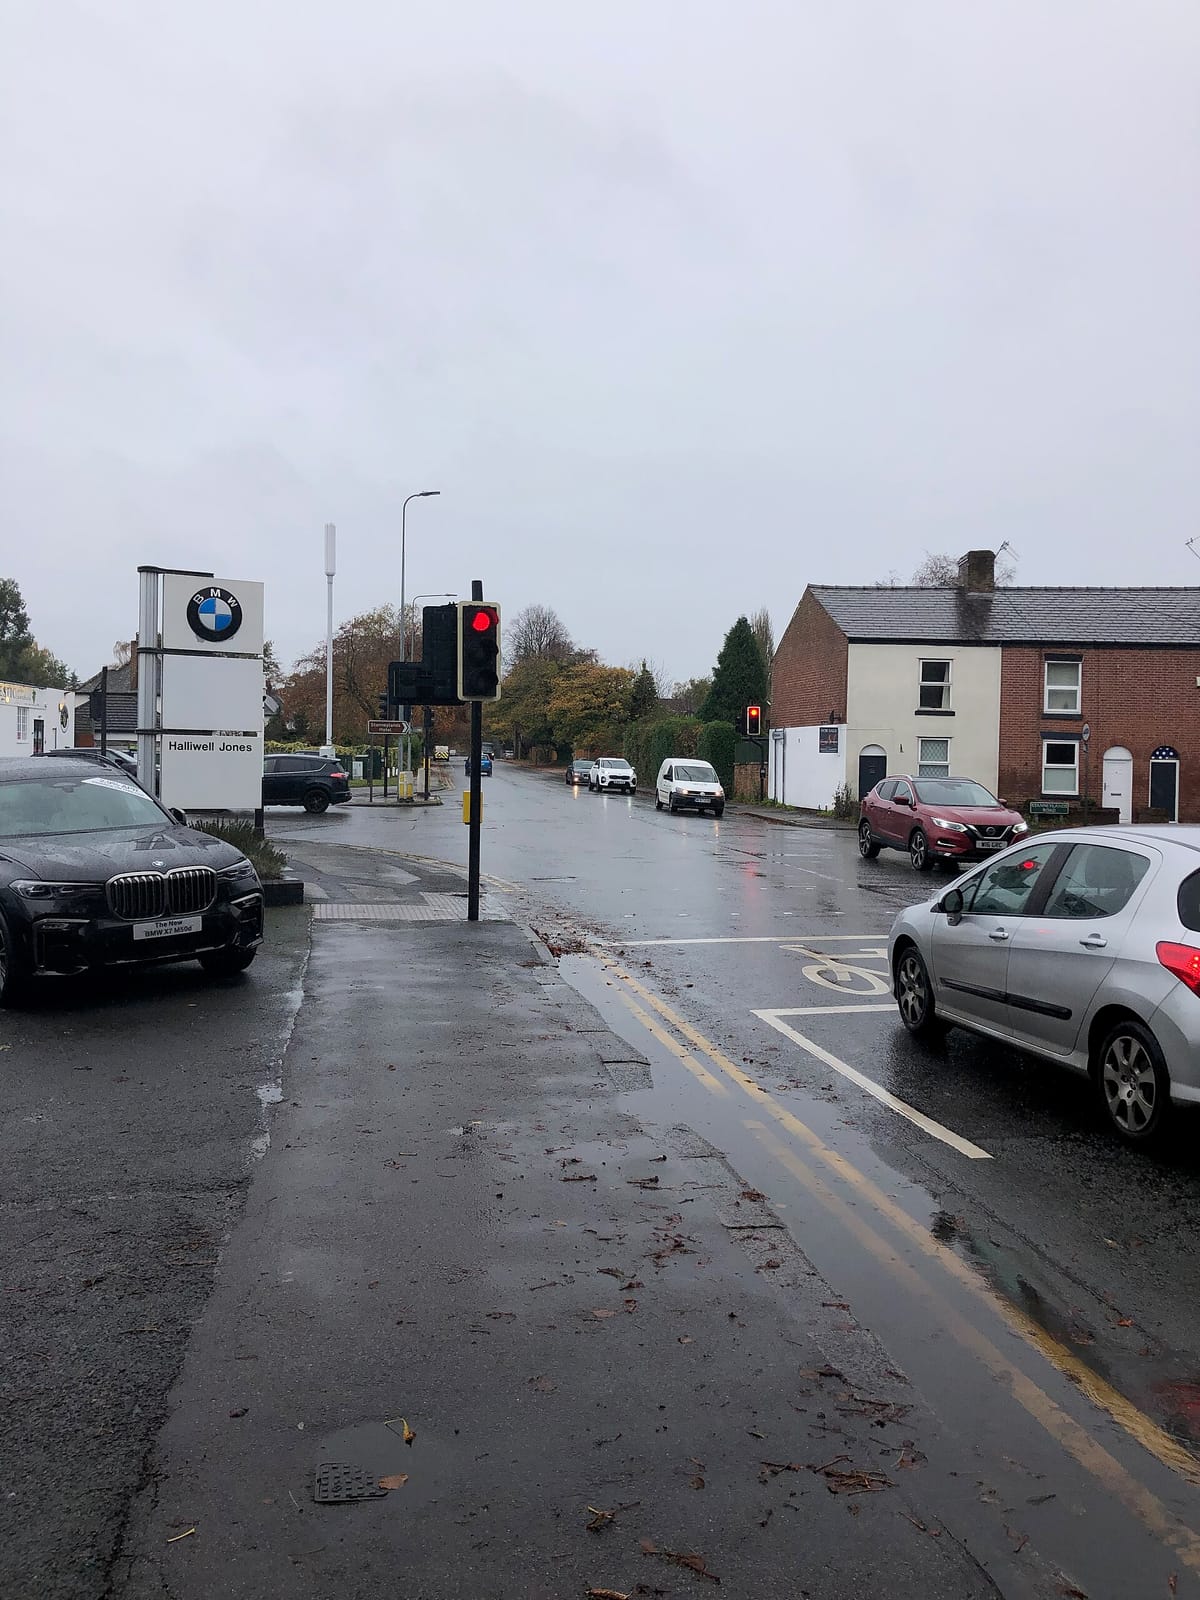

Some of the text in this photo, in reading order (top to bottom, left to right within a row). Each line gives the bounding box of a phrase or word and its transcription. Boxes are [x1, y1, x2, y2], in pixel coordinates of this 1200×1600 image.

[193, 588, 238, 608] BMW
[168, 741, 253, 752] Halliwell Jones
[144, 930, 163, 938] BMW
